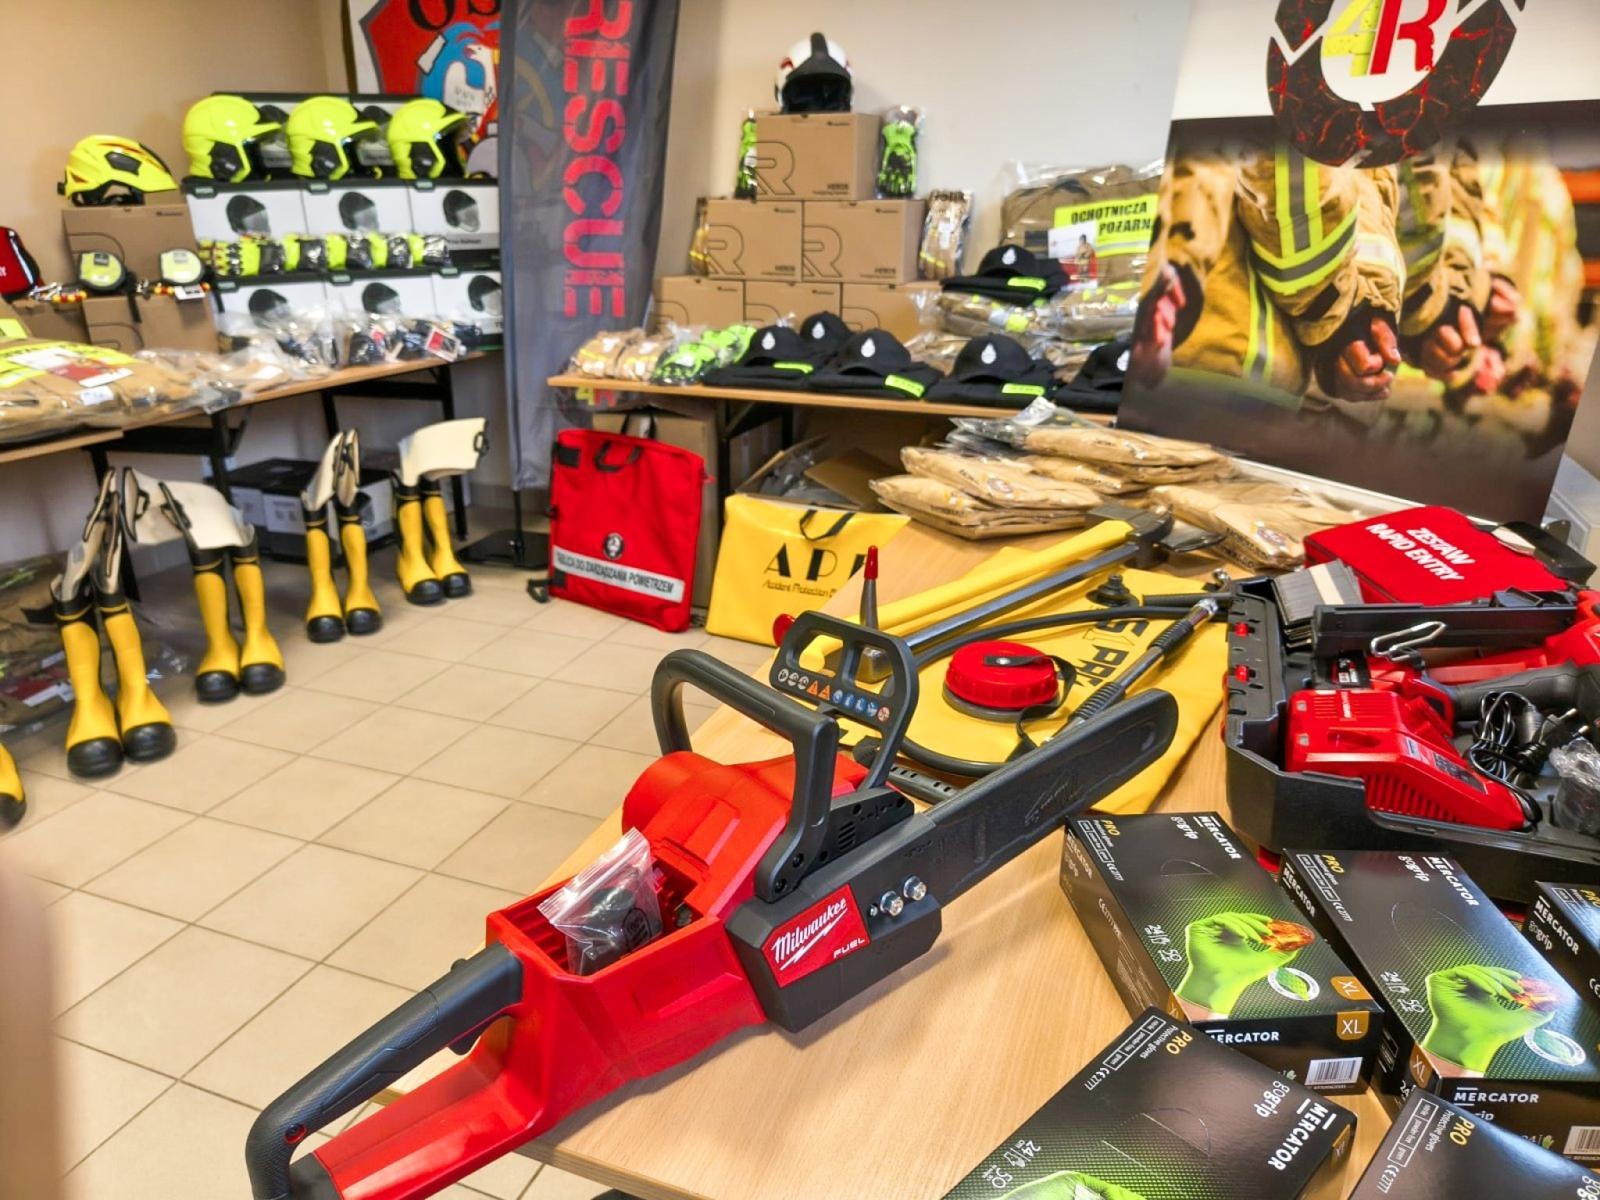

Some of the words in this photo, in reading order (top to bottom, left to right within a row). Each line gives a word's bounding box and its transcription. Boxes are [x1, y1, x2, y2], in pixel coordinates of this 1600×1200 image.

[563, 0, 632, 319] RESCUE
[1070, 201, 1148, 225] OCHOTNICZA
[1364, 522, 1417, 551] RAPID
[1403, 548, 1465, 580] ENTRY
[1405, 527, 1476, 565] ZESTAW
[628, 572, 675, 594] POWIETRZEM
[1100, 819, 1121, 836] PRO
[1198, 815, 1242, 860] MERCATOR
[1321, 854, 1345, 874] PRO
[1397, 855, 1430, 883] gogrip
[1283, 867, 1316, 918] MERCATOR
[1428, 856, 1480, 906] MERCATOR
[770, 897, 847, 964] Milwaukee
[1535, 900, 1580, 956] MERCATOR
[833, 937, 866, 960] FUEL
[1339, 980, 1360, 996] XL
[1341, 1019, 1363, 1035] XL
[1165, 1030, 1194, 1055] PRO
[1412, 1054, 1426, 1083] XL
[1253, 1079, 1291, 1118] gogrip
[1454, 1092, 1540, 1104] MERCATOR
[1267, 1102, 1330, 1171] MERCATOR
[1449, 1115, 1476, 1146] PRO
[1021, 1140, 1041, 1157] 24
